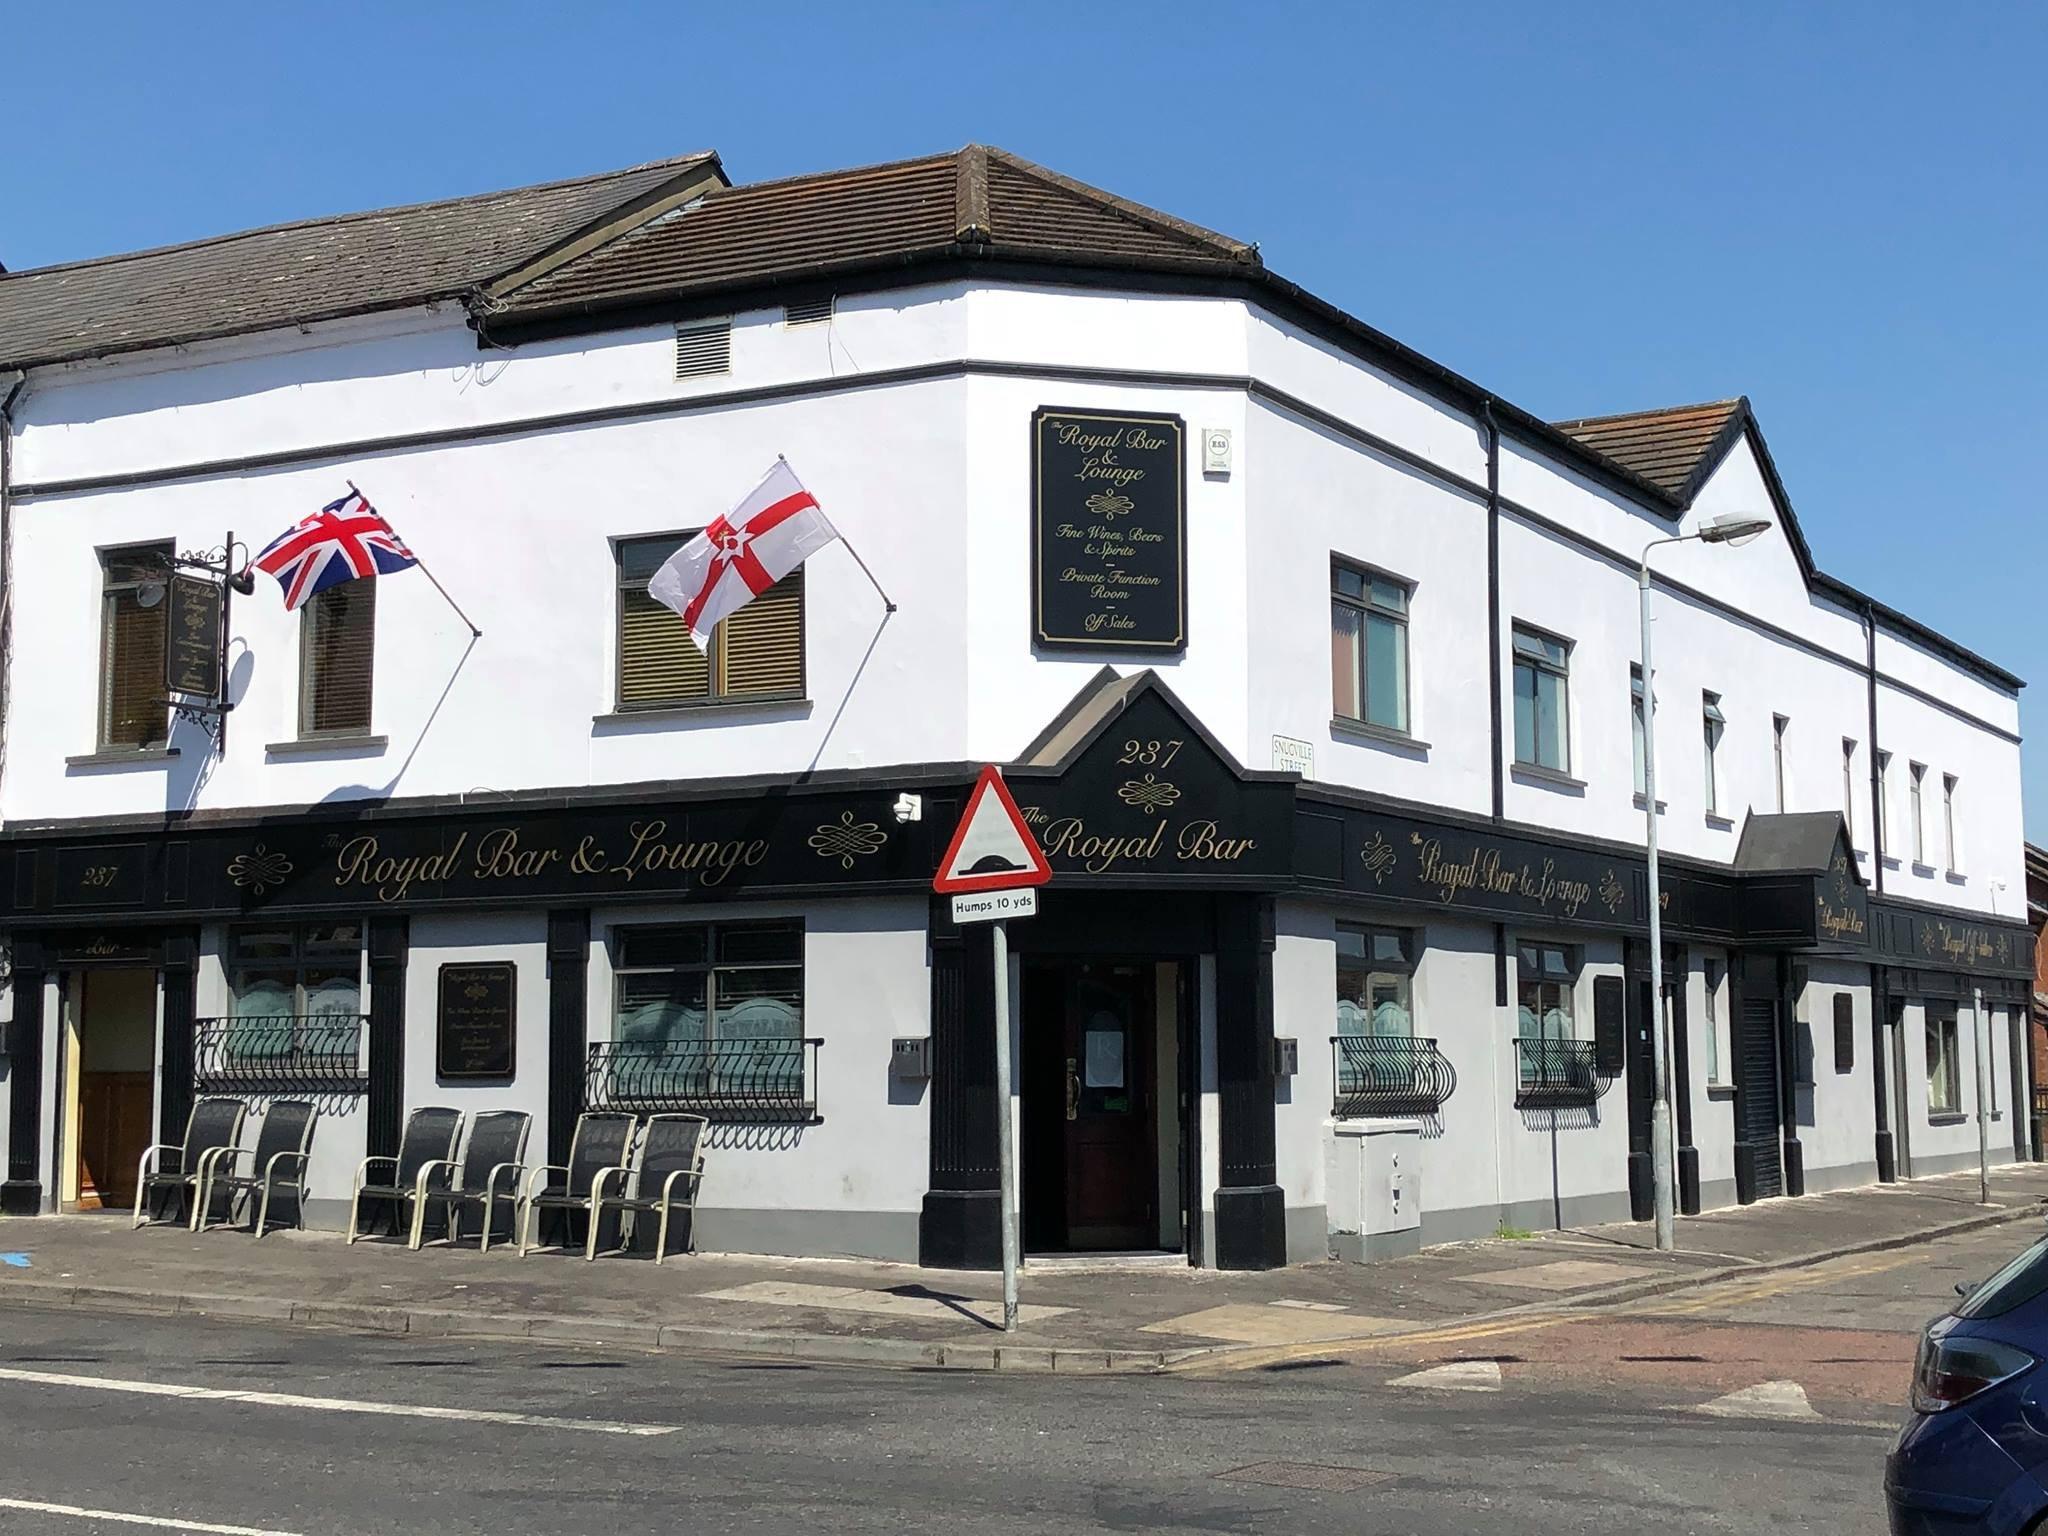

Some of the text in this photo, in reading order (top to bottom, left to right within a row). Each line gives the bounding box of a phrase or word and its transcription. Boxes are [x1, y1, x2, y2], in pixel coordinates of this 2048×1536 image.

[1059, 424, 1123, 453] Royal
[1126, 428, 1167, 450] Bar
[1101, 449, 1119, 465] &
[1074, 457, 1146, 487] Lounge
[1056, 524, 1164, 543] Fine Wines, Beers
[1084, 542, 1136, 560] & Spirits
[1059, 567, 1161, 586] Private Function
[1090, 584, 1130, 600] Room
[1084, 613, 1136, 632] Off Sales
[1116, 739, 1184, 769] 237
[1274, 740, 1311, 760] SNUGVILLE
[1020, 806, 1257, 873] The Royal Bar
[335, 831, 467, 902] Royal
[475, 827, 561, 877] Bar
[570, 835, 607, 873] &
[611, 820, 770, 887] Lounge
[80, 866, 118, 887] 237
[1418, 838, 1480, 904] Royal
[1480, 849, 1518, 893] Bar
[1519, 864, 1535, 897] &
[1534, 857, 1591, 917] Lounge
[956, 896, 1032, 914] Humps 10 yds
[85, 937, 119, 955] Bar
